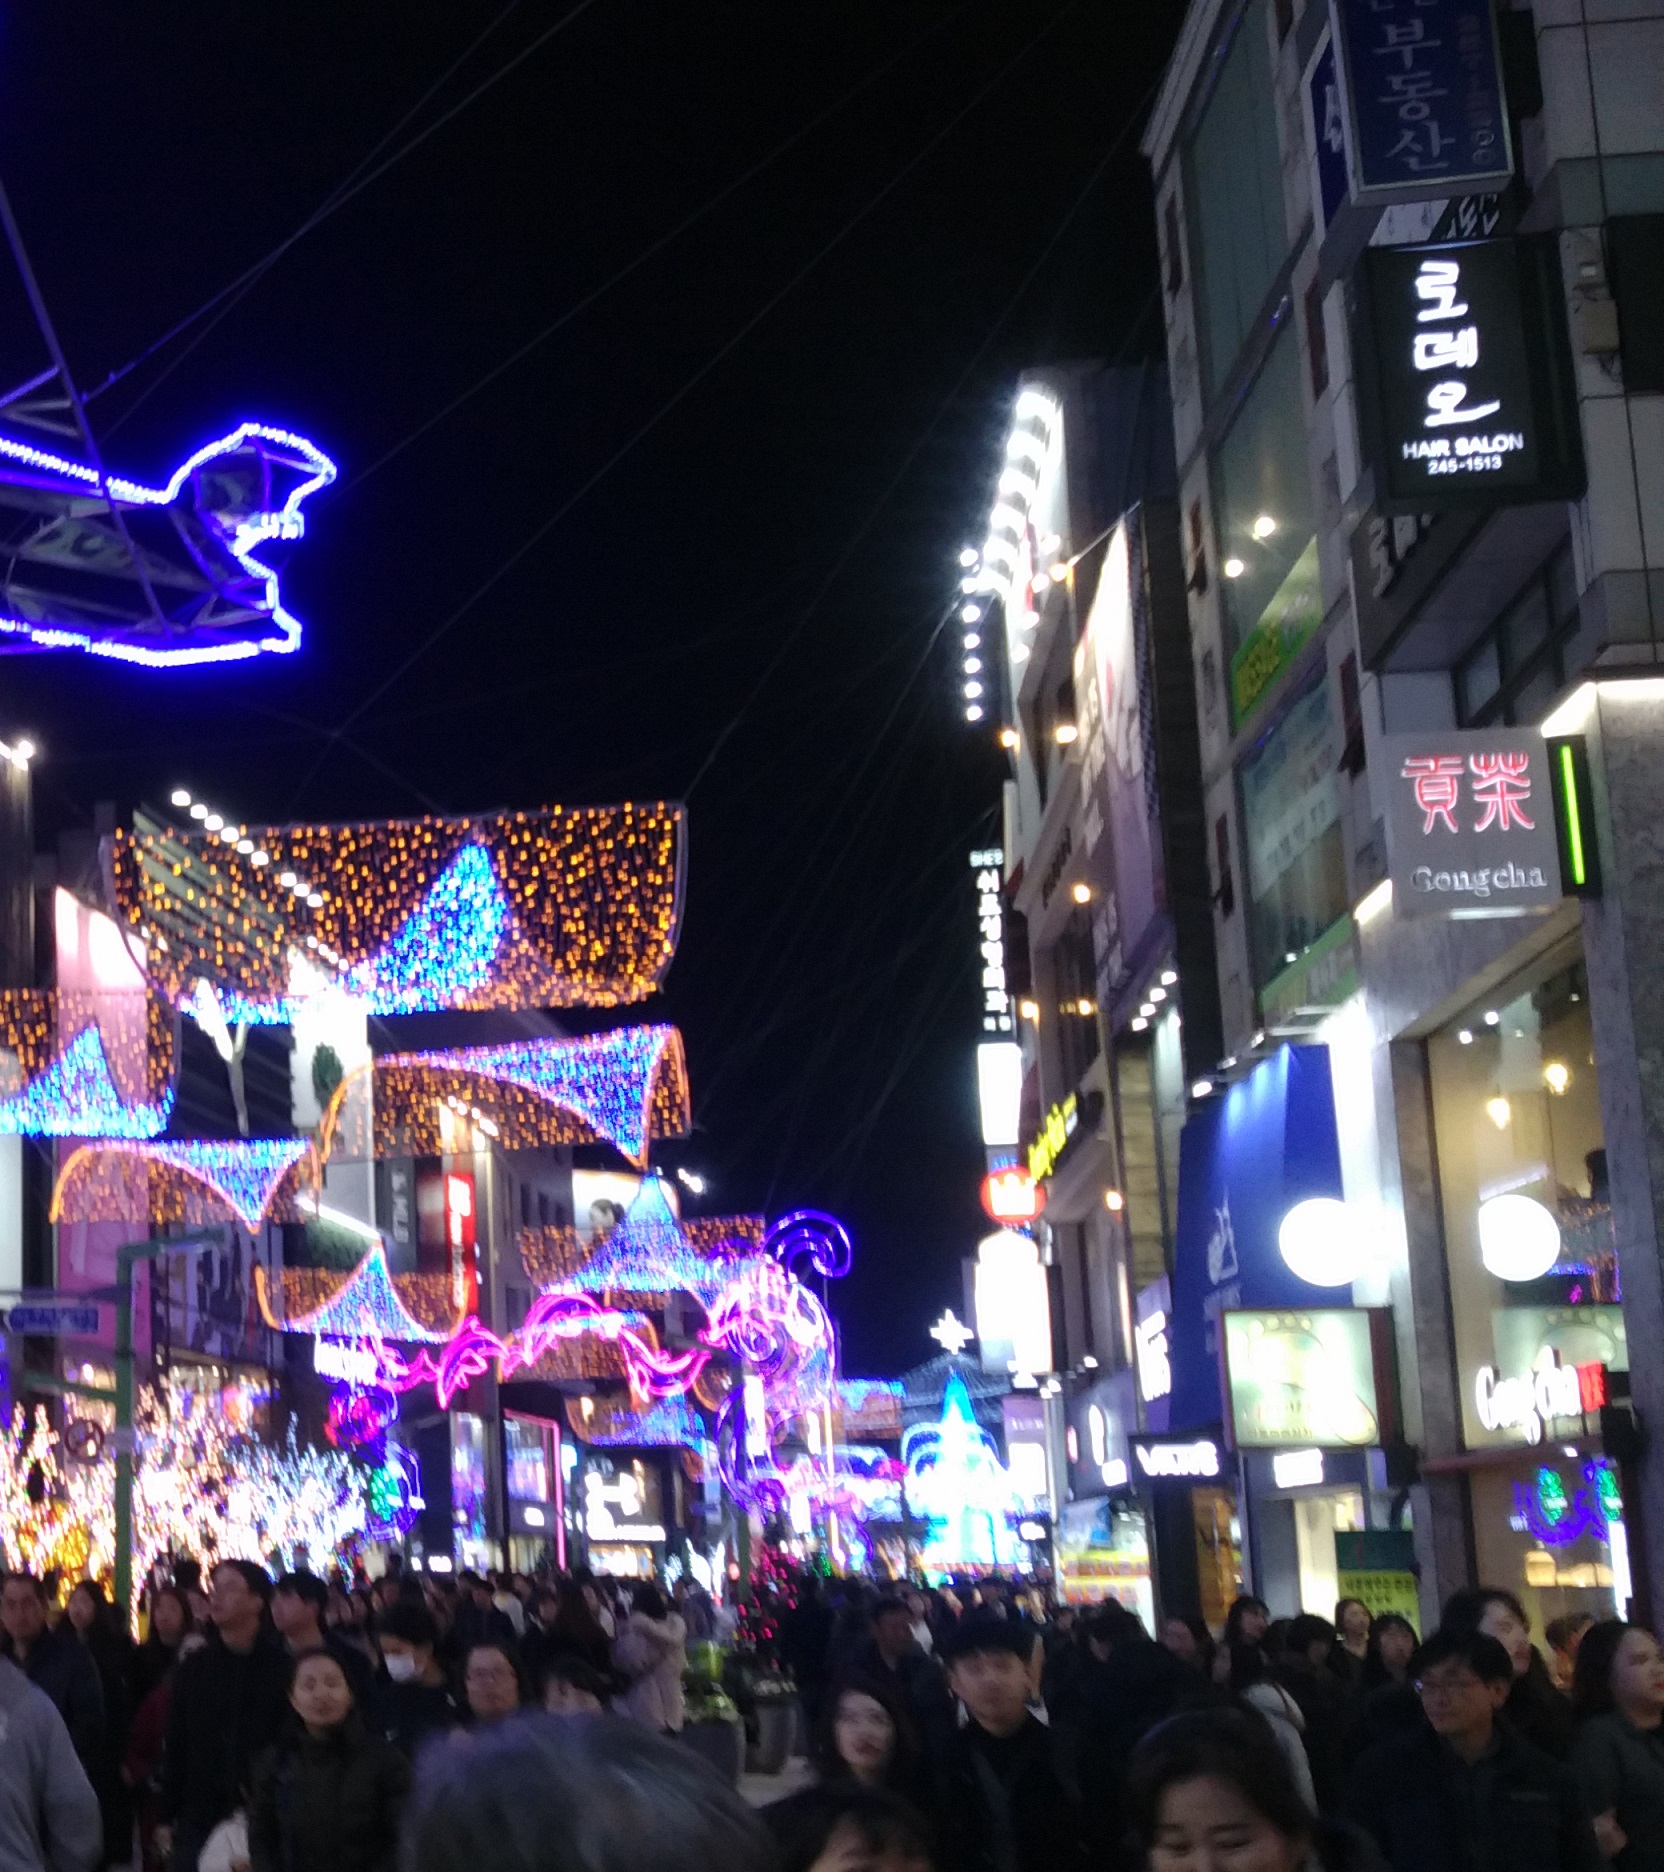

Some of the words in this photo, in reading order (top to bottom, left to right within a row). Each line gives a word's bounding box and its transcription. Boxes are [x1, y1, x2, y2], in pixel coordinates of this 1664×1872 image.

[1372, 18, 1457, 171] 부동산
[1414, 260, 1501, 428] 로데오
[1402, 437, 1451, 460] HAIR
[1454, 432, 1525, 457] SALON
[1427, 455, 1503, 475] 245-1513
